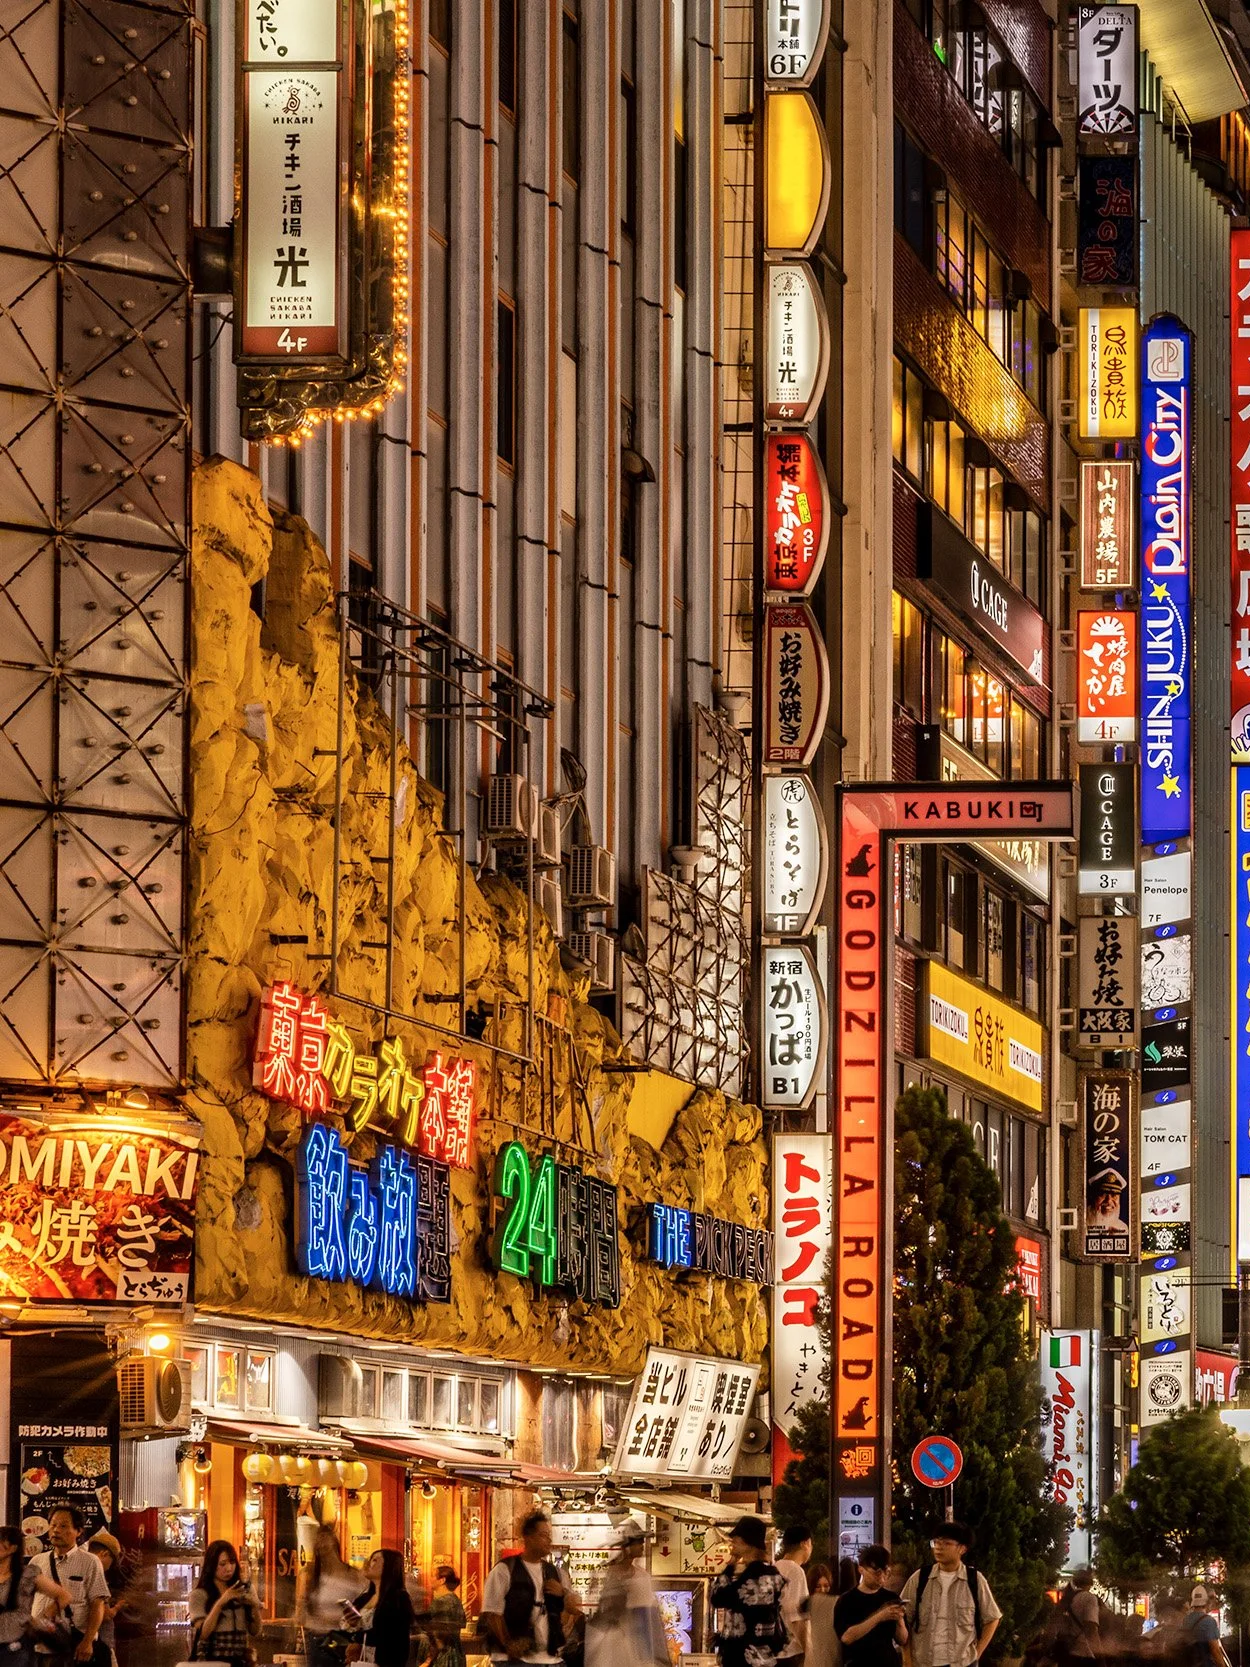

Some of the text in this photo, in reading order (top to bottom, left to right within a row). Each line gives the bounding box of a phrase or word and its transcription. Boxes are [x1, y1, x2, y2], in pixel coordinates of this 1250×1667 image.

[1082, 8, 1094, 18] 8F
[1098, 14, 1133, 25] DELTA
[771, 55, 806, 75] 6F
[1093, 27, 1125, 112] ダーツ
[274, 132, 309, 288] チキン酒場 光
[277, 328, 308, 352] 4F
[778, 361, 797, 383] 光
[1090, 325, 1098, 416] TORIKIZOKU
[779, 404, 794, 417] 4F
[1095, 569, 1118, 583] 5F
[981, 579, 1008, 632] CAGE
[779, 631, 803, 745] お好み焼き
[1094, 721, 1120, 740] 4F
[769, 747, 800, 760] 2階
[1100, 801, 1113, 860] CAGE
[1099, 874, 1118, 889] 3F
[1144, 885, 1188, 895] Penelope
[773, 915, 798, 931] 1F
[1148, 914, 1161, 922] 7F
[769, 961, 803, 975] 新宿
[768, 977, 804, 1066] かっぱ
[1082, 1011, 1132, 1031] 大阪家
[262, 984, 478, 1168] 東京カラオケ本舗
[772, 1078, 799, 1094] B1
[1092, 1084, 1121, 1163] 海の家
[842, 889, 875, 1381] GODZILLA ROAD
[1144, 1135, 1187, 1143] TOM CAT
[652, 1204, 692, 1269] THE
[18, 1424, 108, 1438] 防犯カメラ作動中
